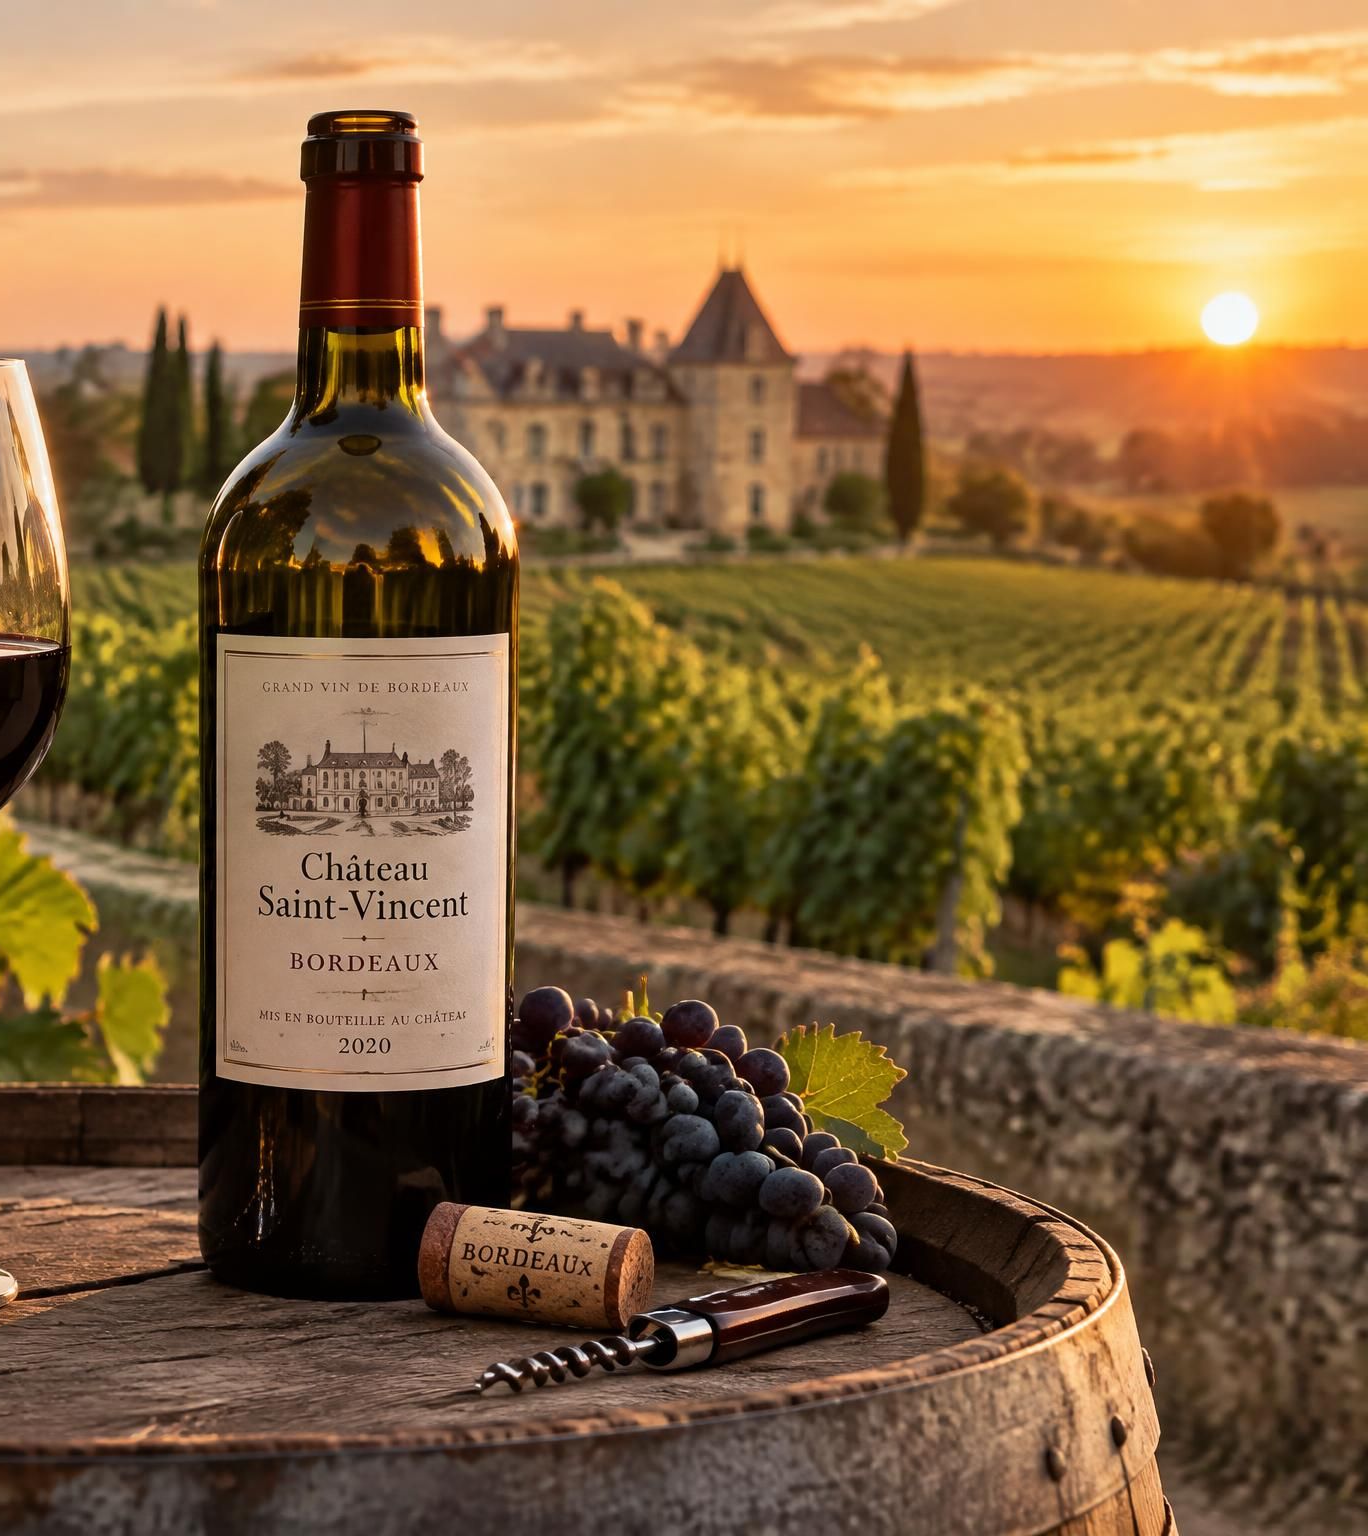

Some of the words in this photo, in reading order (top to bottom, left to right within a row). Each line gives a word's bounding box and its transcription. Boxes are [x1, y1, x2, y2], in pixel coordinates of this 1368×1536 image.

[262, 681, 314, 693] GRAND
[320, 682, 350, 693] VIN
[358, 682, 380, 693] DE
[388, 681, 470, 693] BORDEAUX
[301, 852, 429, 882] Château
[258, 885, 469, 920] Saint-Vincent
[289, 952, 439, 972] BORDEAUX
[259, 1010, 281, 1022] MIS
[285, 1012, 302, 1023] EN
[306, 1014, 386, 1026] BOUTEILLE
[391, 1015, 410, 1026] AU
[338, 1037, 391, 1055] 2020
[461, 1242, 593, 1277] BORDEAUX
